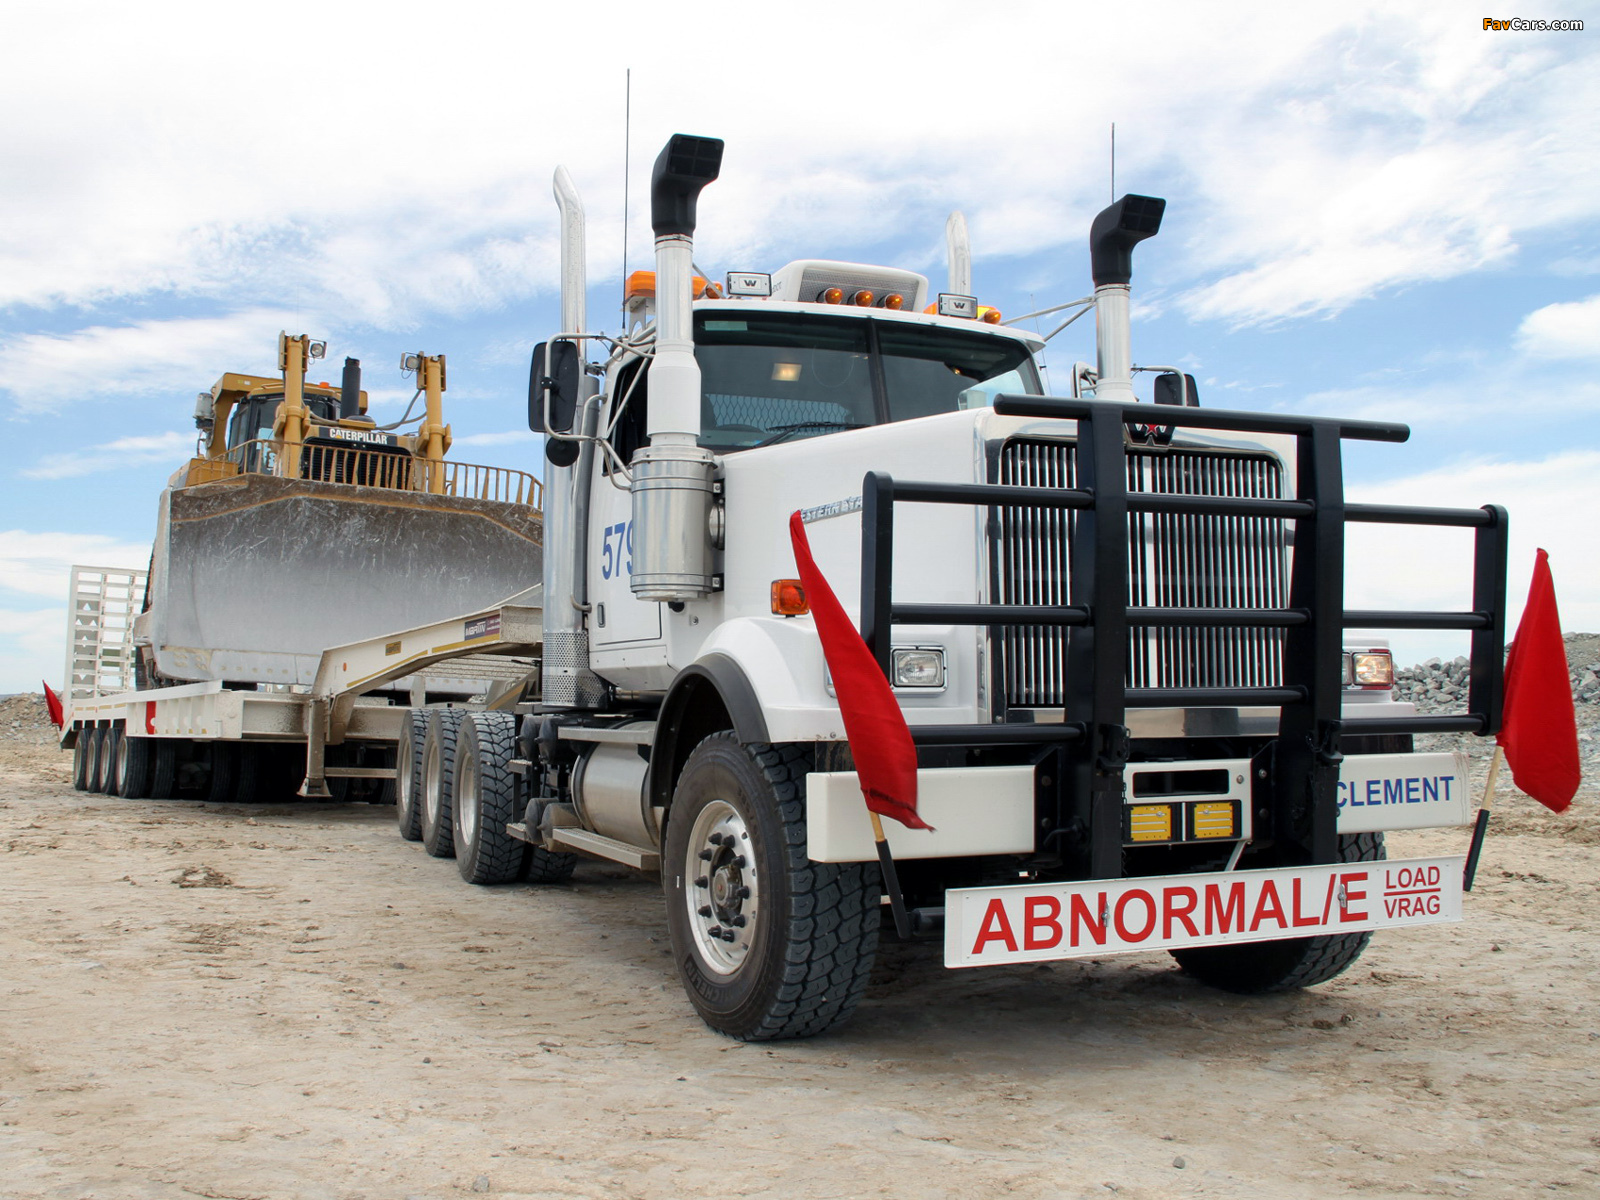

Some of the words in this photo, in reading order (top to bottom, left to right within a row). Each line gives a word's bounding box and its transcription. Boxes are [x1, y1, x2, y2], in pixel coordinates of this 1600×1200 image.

[329, 428, 388, 445] CATERPILLAR
[791, 501, 842, 523] ESTERN
[1337, 776, 1454, 808] CLEMENT
[1386, 866, 1440, 889] LOAD
[972, 872, 1368, 955] ABNORMAL/E
[1384, 895, 1440, 918] VRAG
